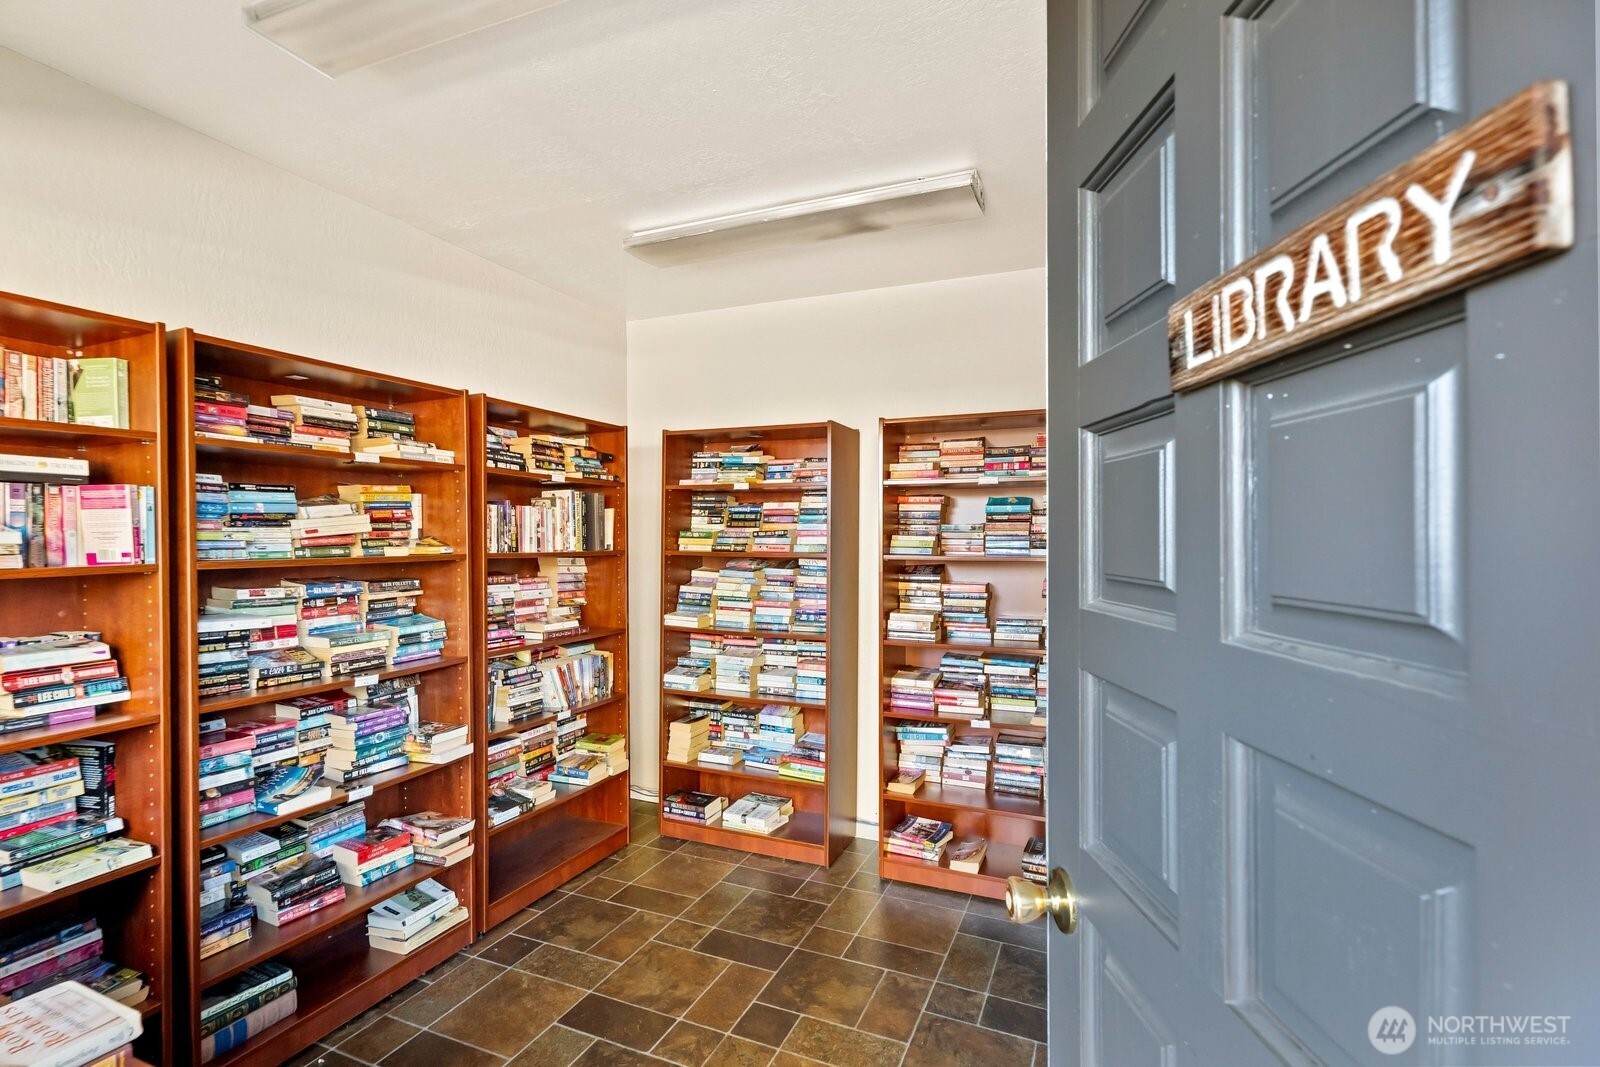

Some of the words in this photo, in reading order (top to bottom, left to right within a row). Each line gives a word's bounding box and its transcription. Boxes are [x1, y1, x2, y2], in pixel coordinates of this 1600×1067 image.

[1184, 150, 1476, 369] LIBRARY
[38, 691, 54, 702] LEE
[53, 688, 76, 700] CHILD
